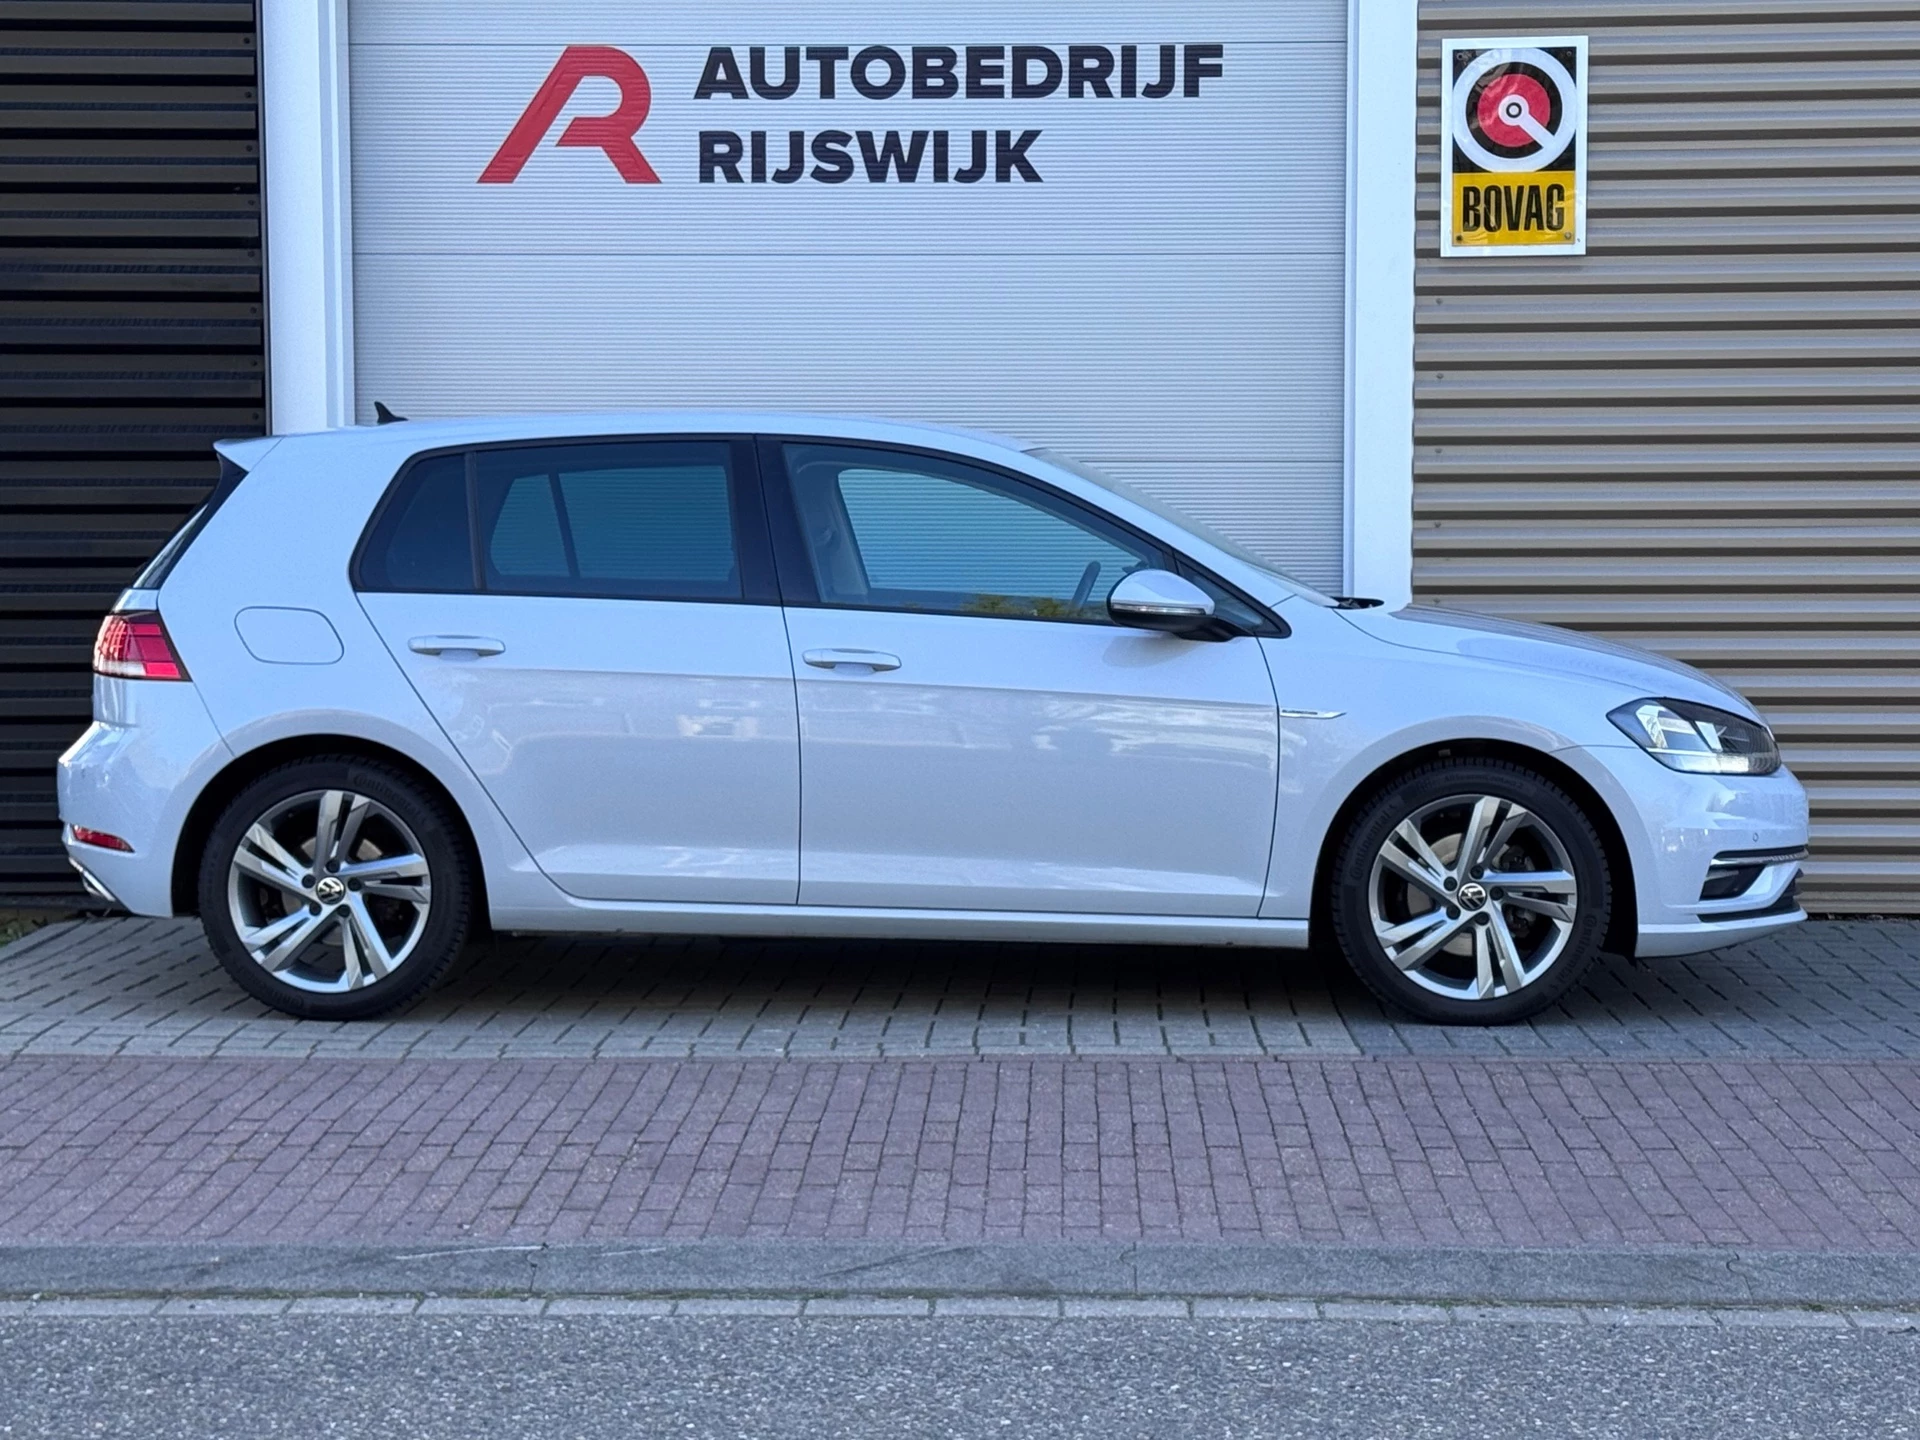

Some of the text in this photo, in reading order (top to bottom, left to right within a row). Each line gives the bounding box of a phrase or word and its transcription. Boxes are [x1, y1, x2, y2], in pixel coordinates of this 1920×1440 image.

[694, 46, 1223, 100] AUTOBEDRIJF
[699, 130, 1043, 183] RIJSWIJK
[1463, 184, 1565, 232] BOVAG
